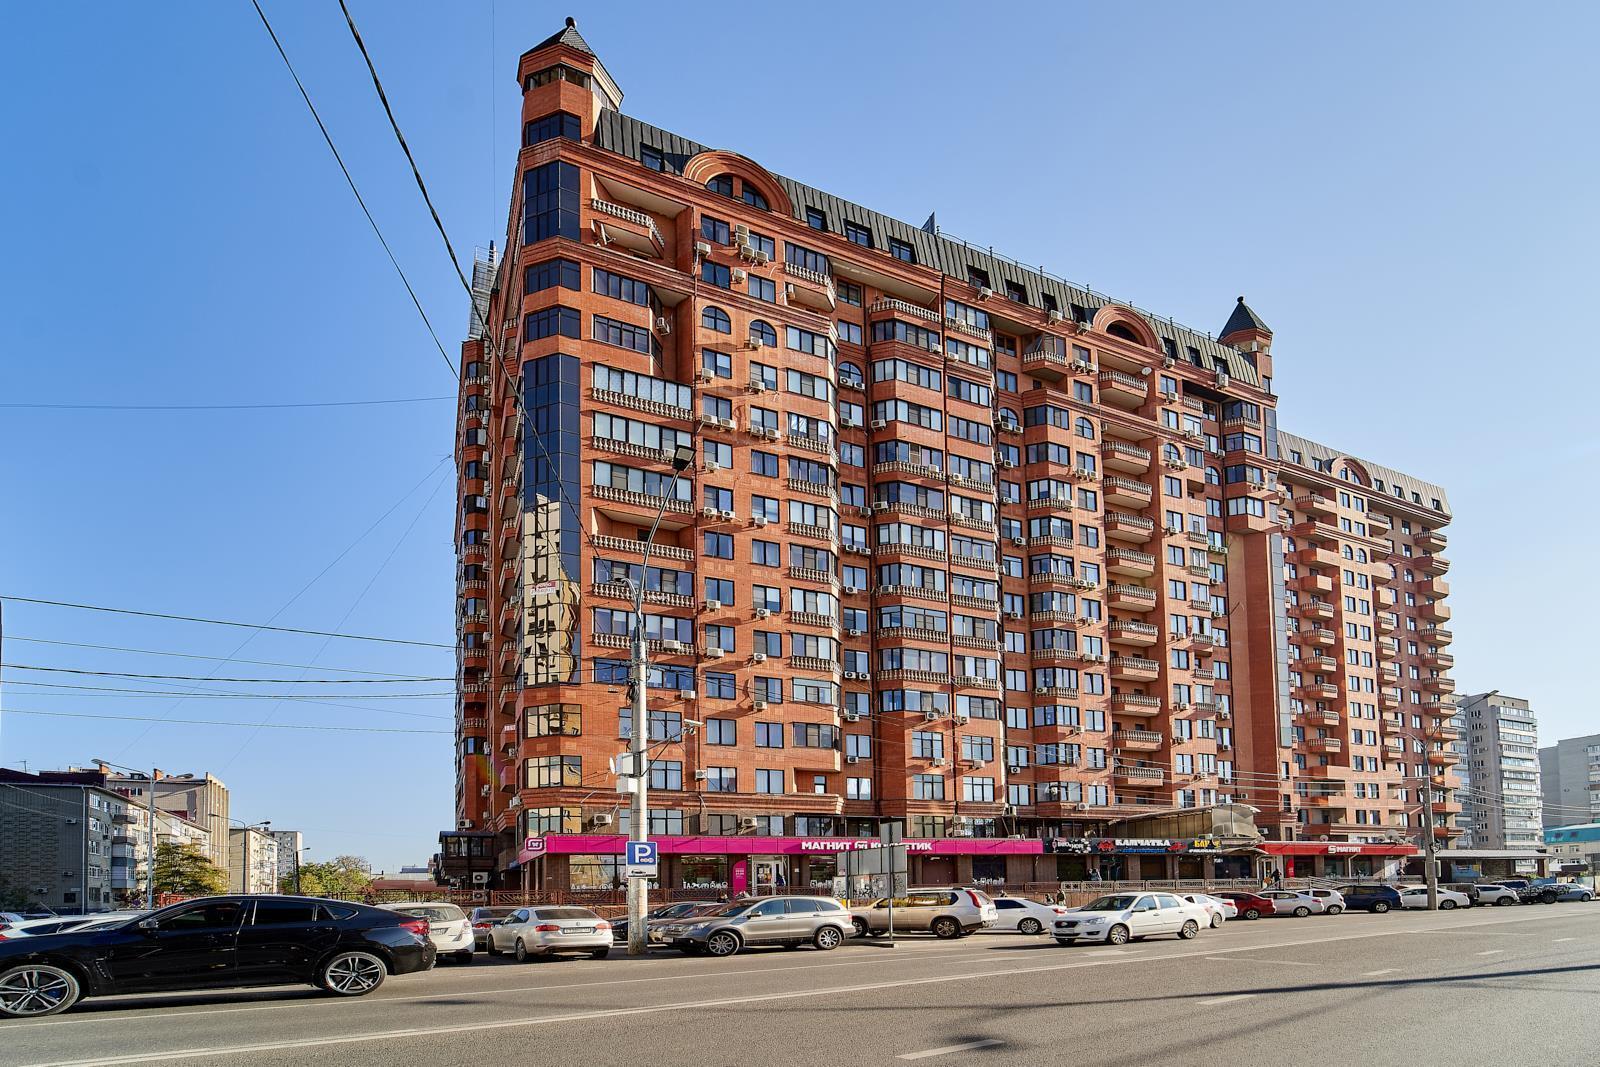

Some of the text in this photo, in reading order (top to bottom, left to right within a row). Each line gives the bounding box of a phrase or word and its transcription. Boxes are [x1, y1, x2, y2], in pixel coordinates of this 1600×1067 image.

[801, 841, 933, 850] МАГНИТ КЕТИК
[1115, 839, 1171, 847] КАМЧАТКА
[1194, 839, 1210, 848] БАР
[634, 844, 652, 864] P
